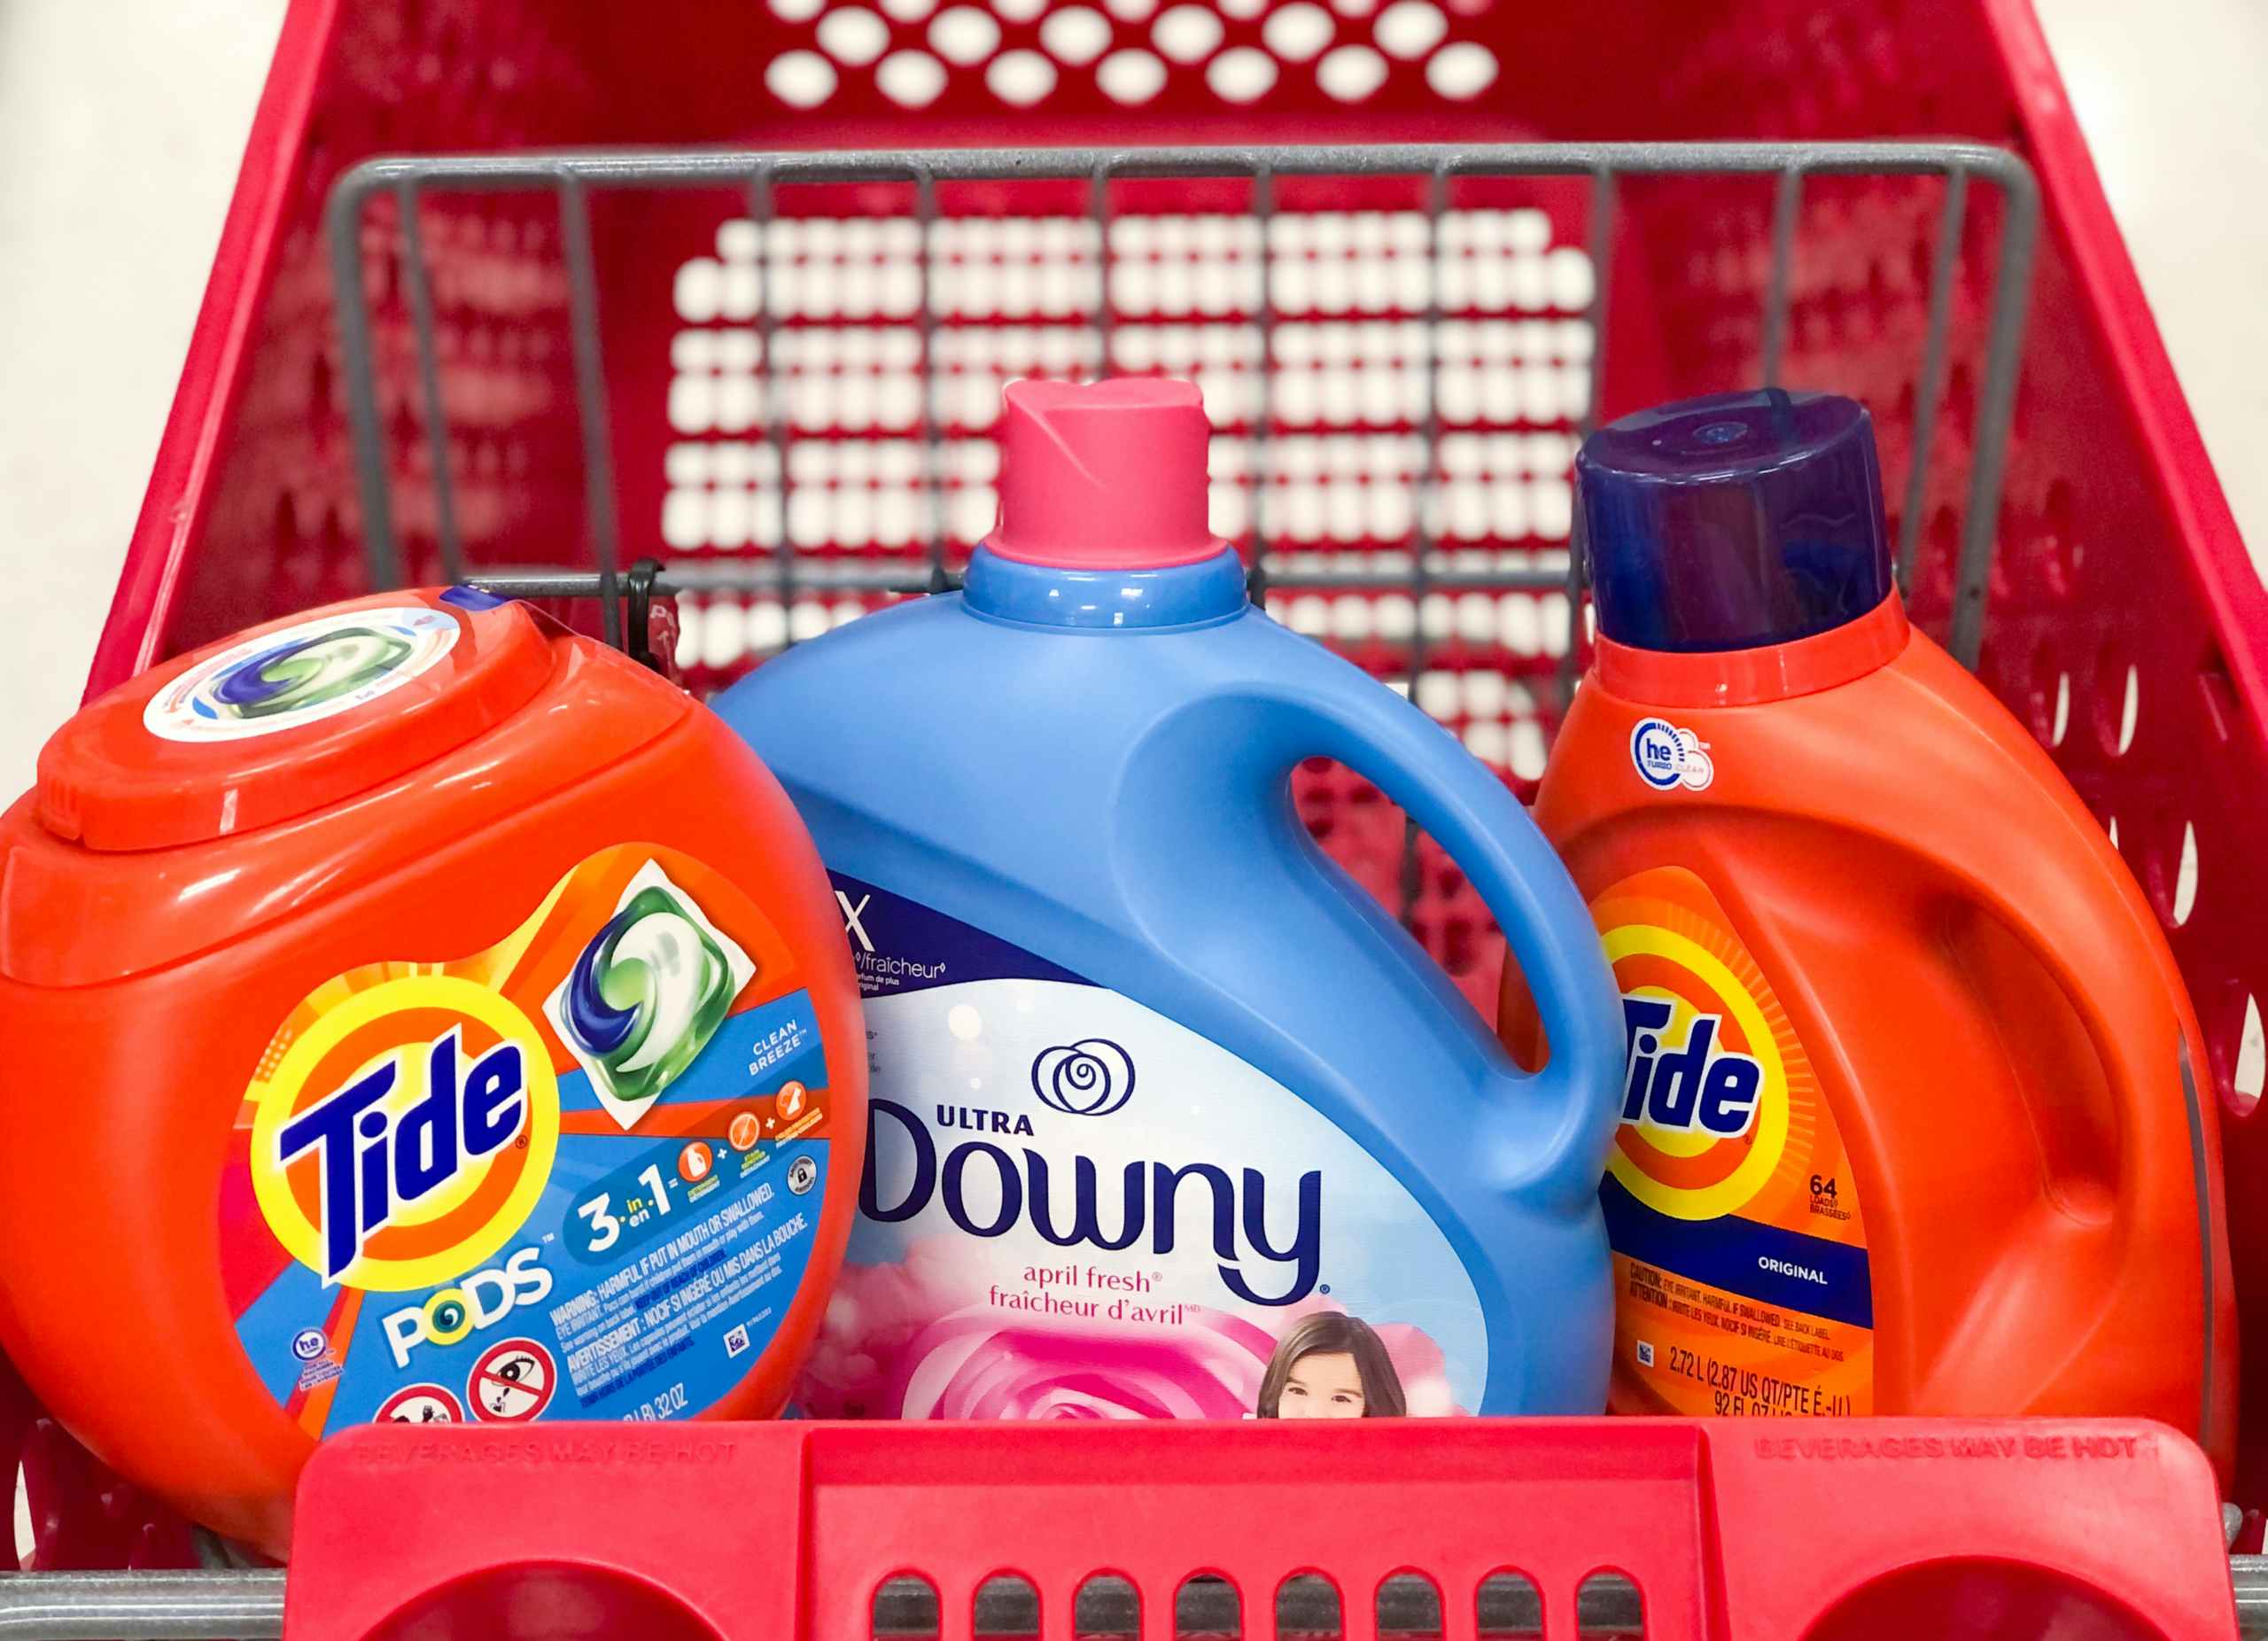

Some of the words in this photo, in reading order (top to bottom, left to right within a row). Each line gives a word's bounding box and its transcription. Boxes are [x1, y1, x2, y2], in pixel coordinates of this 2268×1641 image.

[1646, 738, 1672, 761] he
[753, 1019, 797, 1055] CLEAN
[936, 1104, 1034, 1136] ULTRA
[1810, 1174, 1837, 1199] 64
[578, 1193, 619, 1252] 3
[638, 1168, 671, 1216] 1
[629, 1209, 650, 1227] en
[549, 1288, 600, 1326] WARNING:
[597, 1264, 643, 1302] HARMFUL
[639, 1256, 650, 1276] IF
[648, 1246, 667, 1271] PUT
[665, 1242, 679, 1260] IN
[676, 1221, 710, 1254] MOUTH
[708, 1214, 724, 1235] OR
[719, 1182, 775, 1227] SWALLOWED.
[644, 1299, 671, 1328] NOCIF
[670, 1294, 682, 1313] SI
[710, 1270, 726, 1287] OU
[723, 1256, 742, 1279] MIS
[739, 1240, 765, 1270] DANS
[762, 1233, 776, 1254] LA
[773, 1211, 808, 1248] BOUCHE.
[1024, 1265, 1077, 1288] april
[1630, 1261, 1660, 1287] CAUTION:
[1759, 1256, 1828, 1284] ORIGINAL
[990, 1285, 1099, 1318] fraîcheur
[299, 1337, 319, 1351] he
[1669, 1345, 1694, 1378] 2.72
[1697, 1356, 1704, 1382] L
[1706, 1358, 1737, 1392] (2.87
[1740, 1369, 1759, 1399] US
[1761, 1376, 1809, 1414] QT/PTE
[655, 1393, 672, 1419] 32
[670, 1382, 688, 1410] OZ
[1714, 1390, 1730, 1416] 92
[357, 1440, 540, 1464] BEVERAGES
[553, 1439, 615, 1463] MAY
[622, 1439, 668, 1463] BE
[673, 1439, 737, 1463] HOT
[1754, 1436, 1944, 1459] BEVERAGES
[1948, 1435, 2016, 1459] MAY
[2023, 1435, 2067, 1459] BE
[2072, 1435, 2139, 1459] HOT
